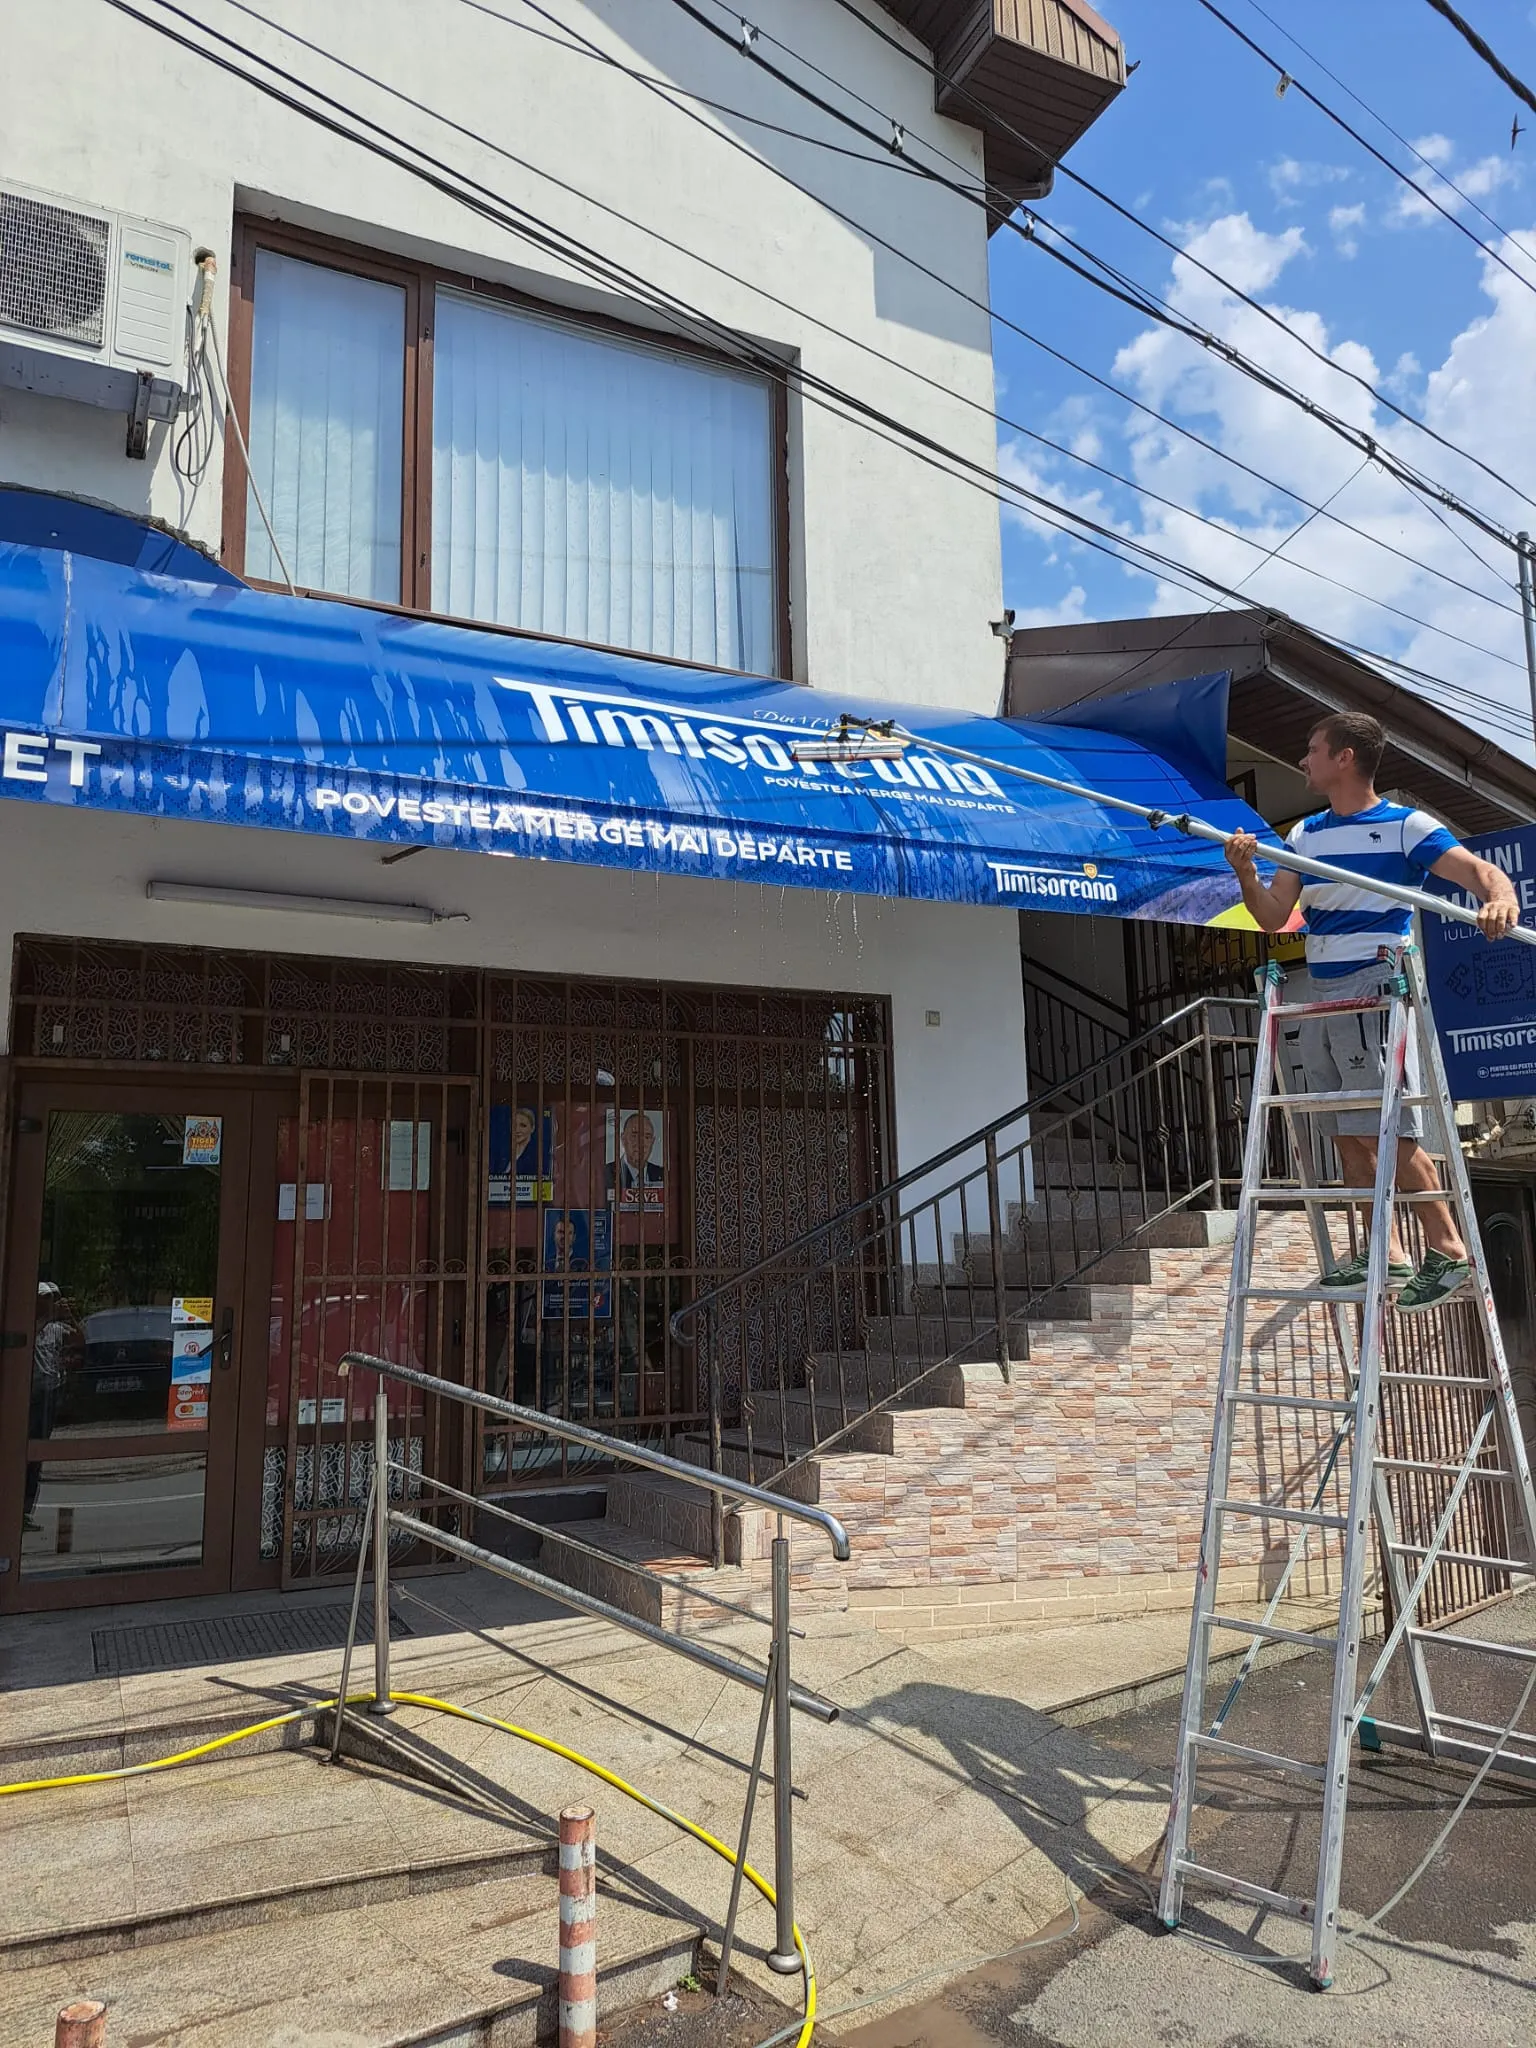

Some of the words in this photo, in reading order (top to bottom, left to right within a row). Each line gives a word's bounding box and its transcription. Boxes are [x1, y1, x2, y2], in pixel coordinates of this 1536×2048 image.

[754, 709, 796, 724] Din
[3, 732, 101, 786] ET
[764, 776, 854, 795] POVESTEA
[856, 787, 913, 801] MERGE
[915, 793, 943, 805] MAI
[948, 798, 1017, 814] DEPARTE
[316, 788, 517, 833] POVESTEA
[522, 812, 644, 848] MERGE
[652, 829, 708, 855] MAI
[716, 837, 853, 871] DEPARTE
[1474, 843, 1523, 874] INI
[987, 862, 1117, 902] Timișoreana
